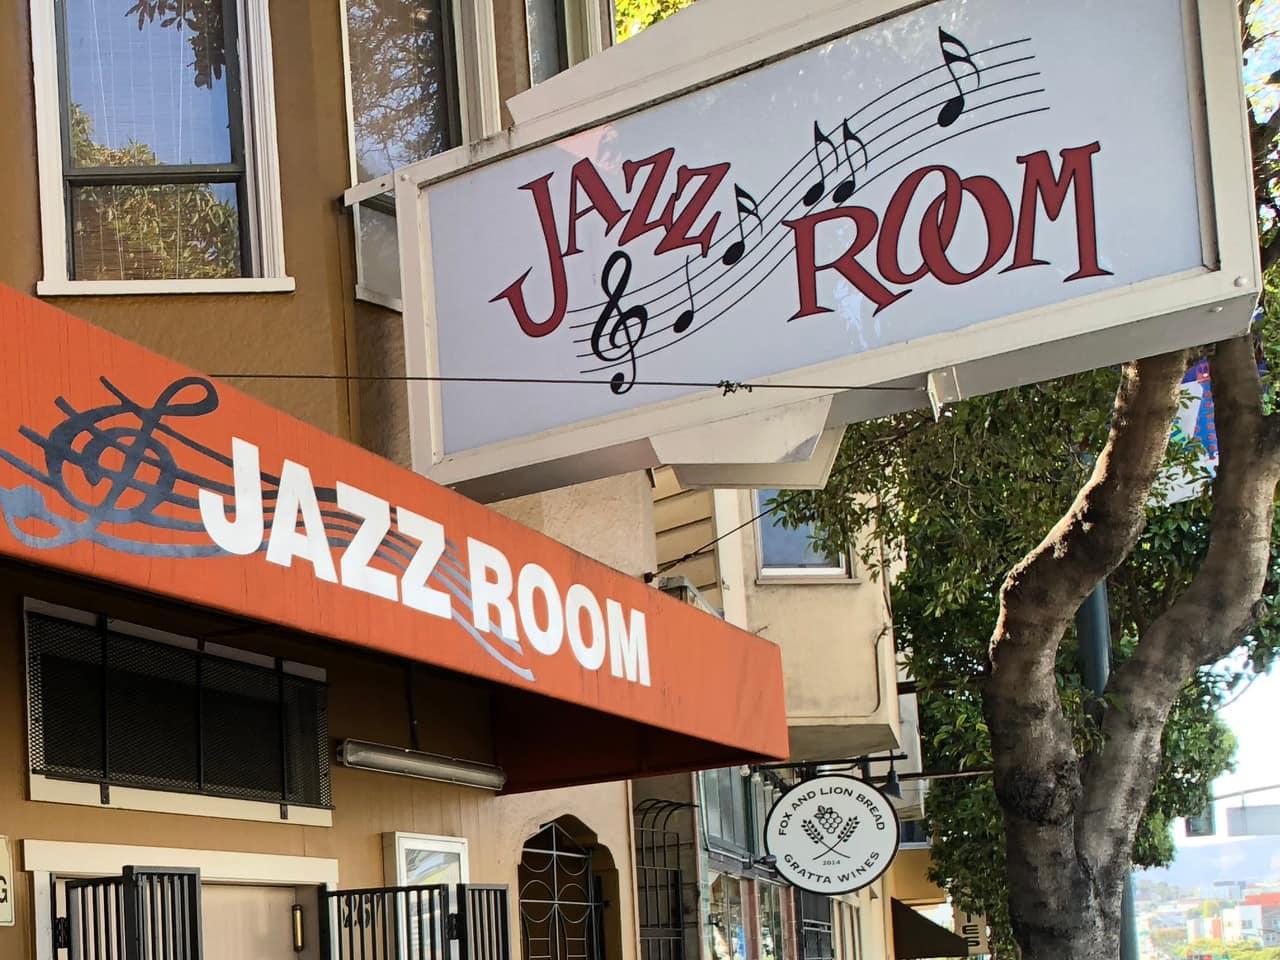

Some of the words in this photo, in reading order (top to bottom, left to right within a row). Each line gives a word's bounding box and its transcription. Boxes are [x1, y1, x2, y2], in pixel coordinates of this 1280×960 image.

[489, 147, 732, 338] JAZZ
[781, 141, 1115, 323] ROOM
[198, 436, 452, 620] JAZZ
[467, 535, 651, 687] ROOM
[778, 811, 793, 836] FOX
[791, 790, 817, 811] AND
[819, 786, 854, 797] LION
[856, 793, 886, 831] BREAD
[783, 853, 832, 884] GRATTA
[837, 851, 880, 883] WINES
